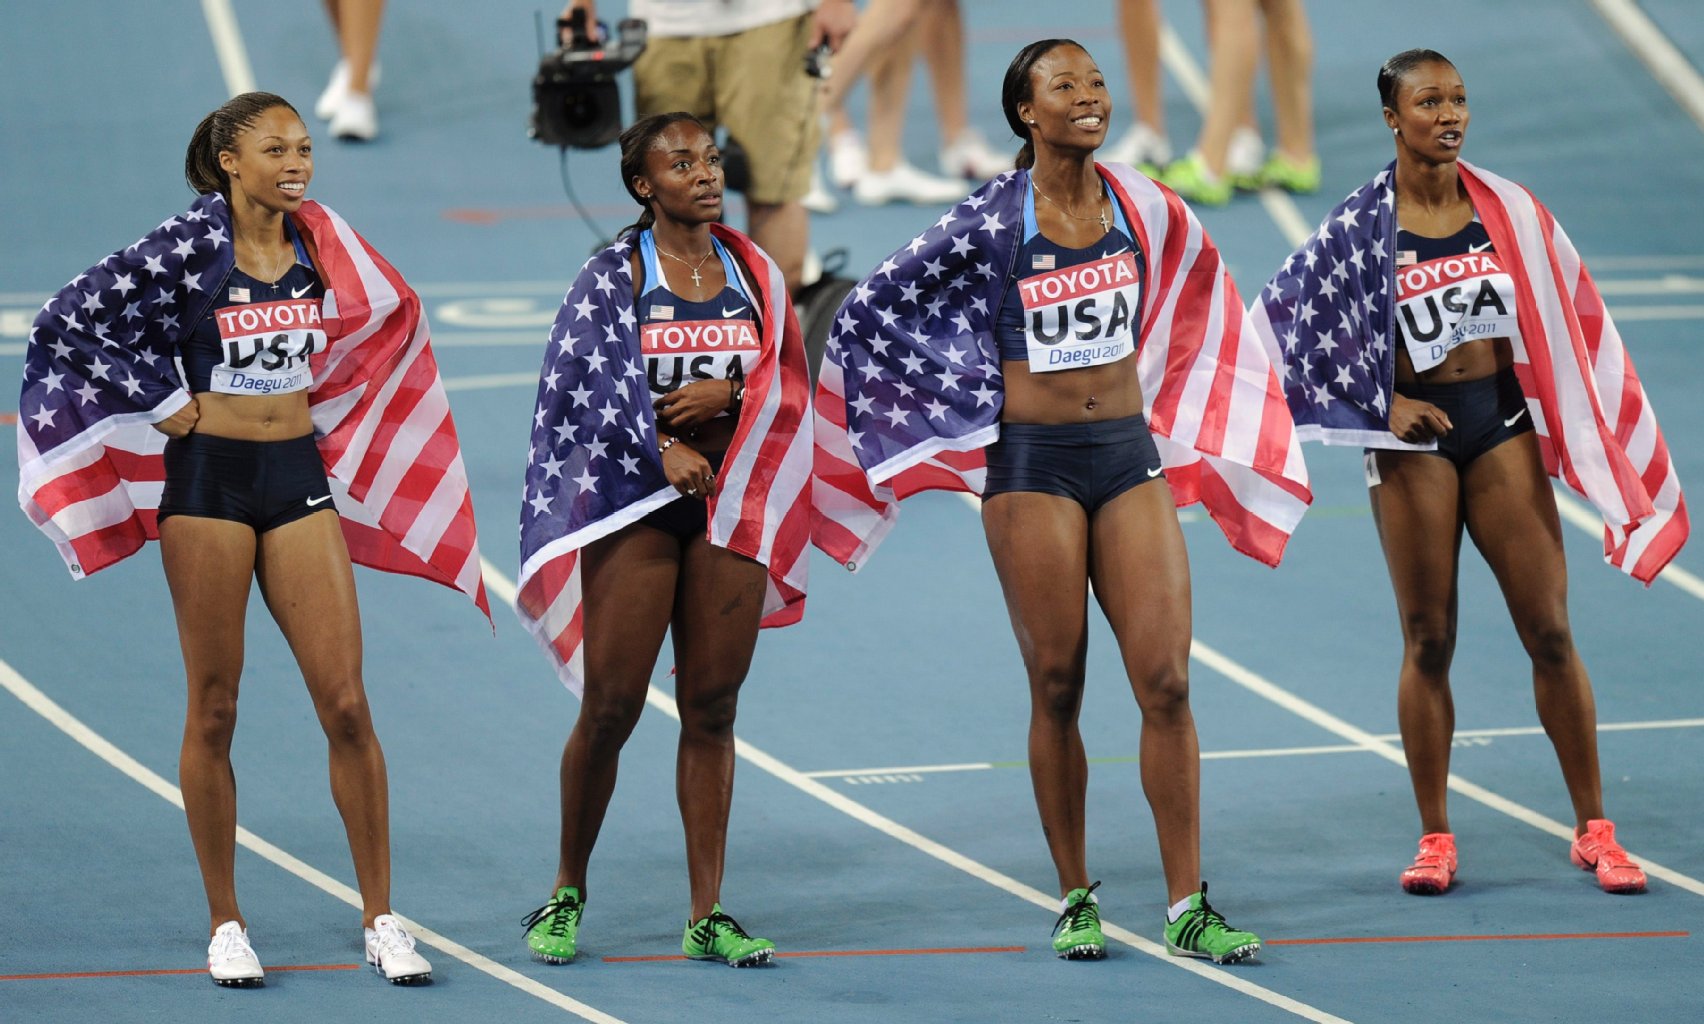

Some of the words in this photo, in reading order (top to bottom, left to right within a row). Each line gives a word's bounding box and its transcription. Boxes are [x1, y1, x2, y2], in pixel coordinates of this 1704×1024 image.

[1023, 260, 1134, 303] TOYOTA
[1396, 256, 1501, 296] TOYOTA
[220, 304, 322, 333] TOYOTA
[1032, 290, 1129, 346] USA
[1469, 323, 1496, 335] 2011
[646, 325, 756, 349] TOYOTA
[1049, 349, 1101, 366] Daegu
[230, 373, 281, 394] Daegu
